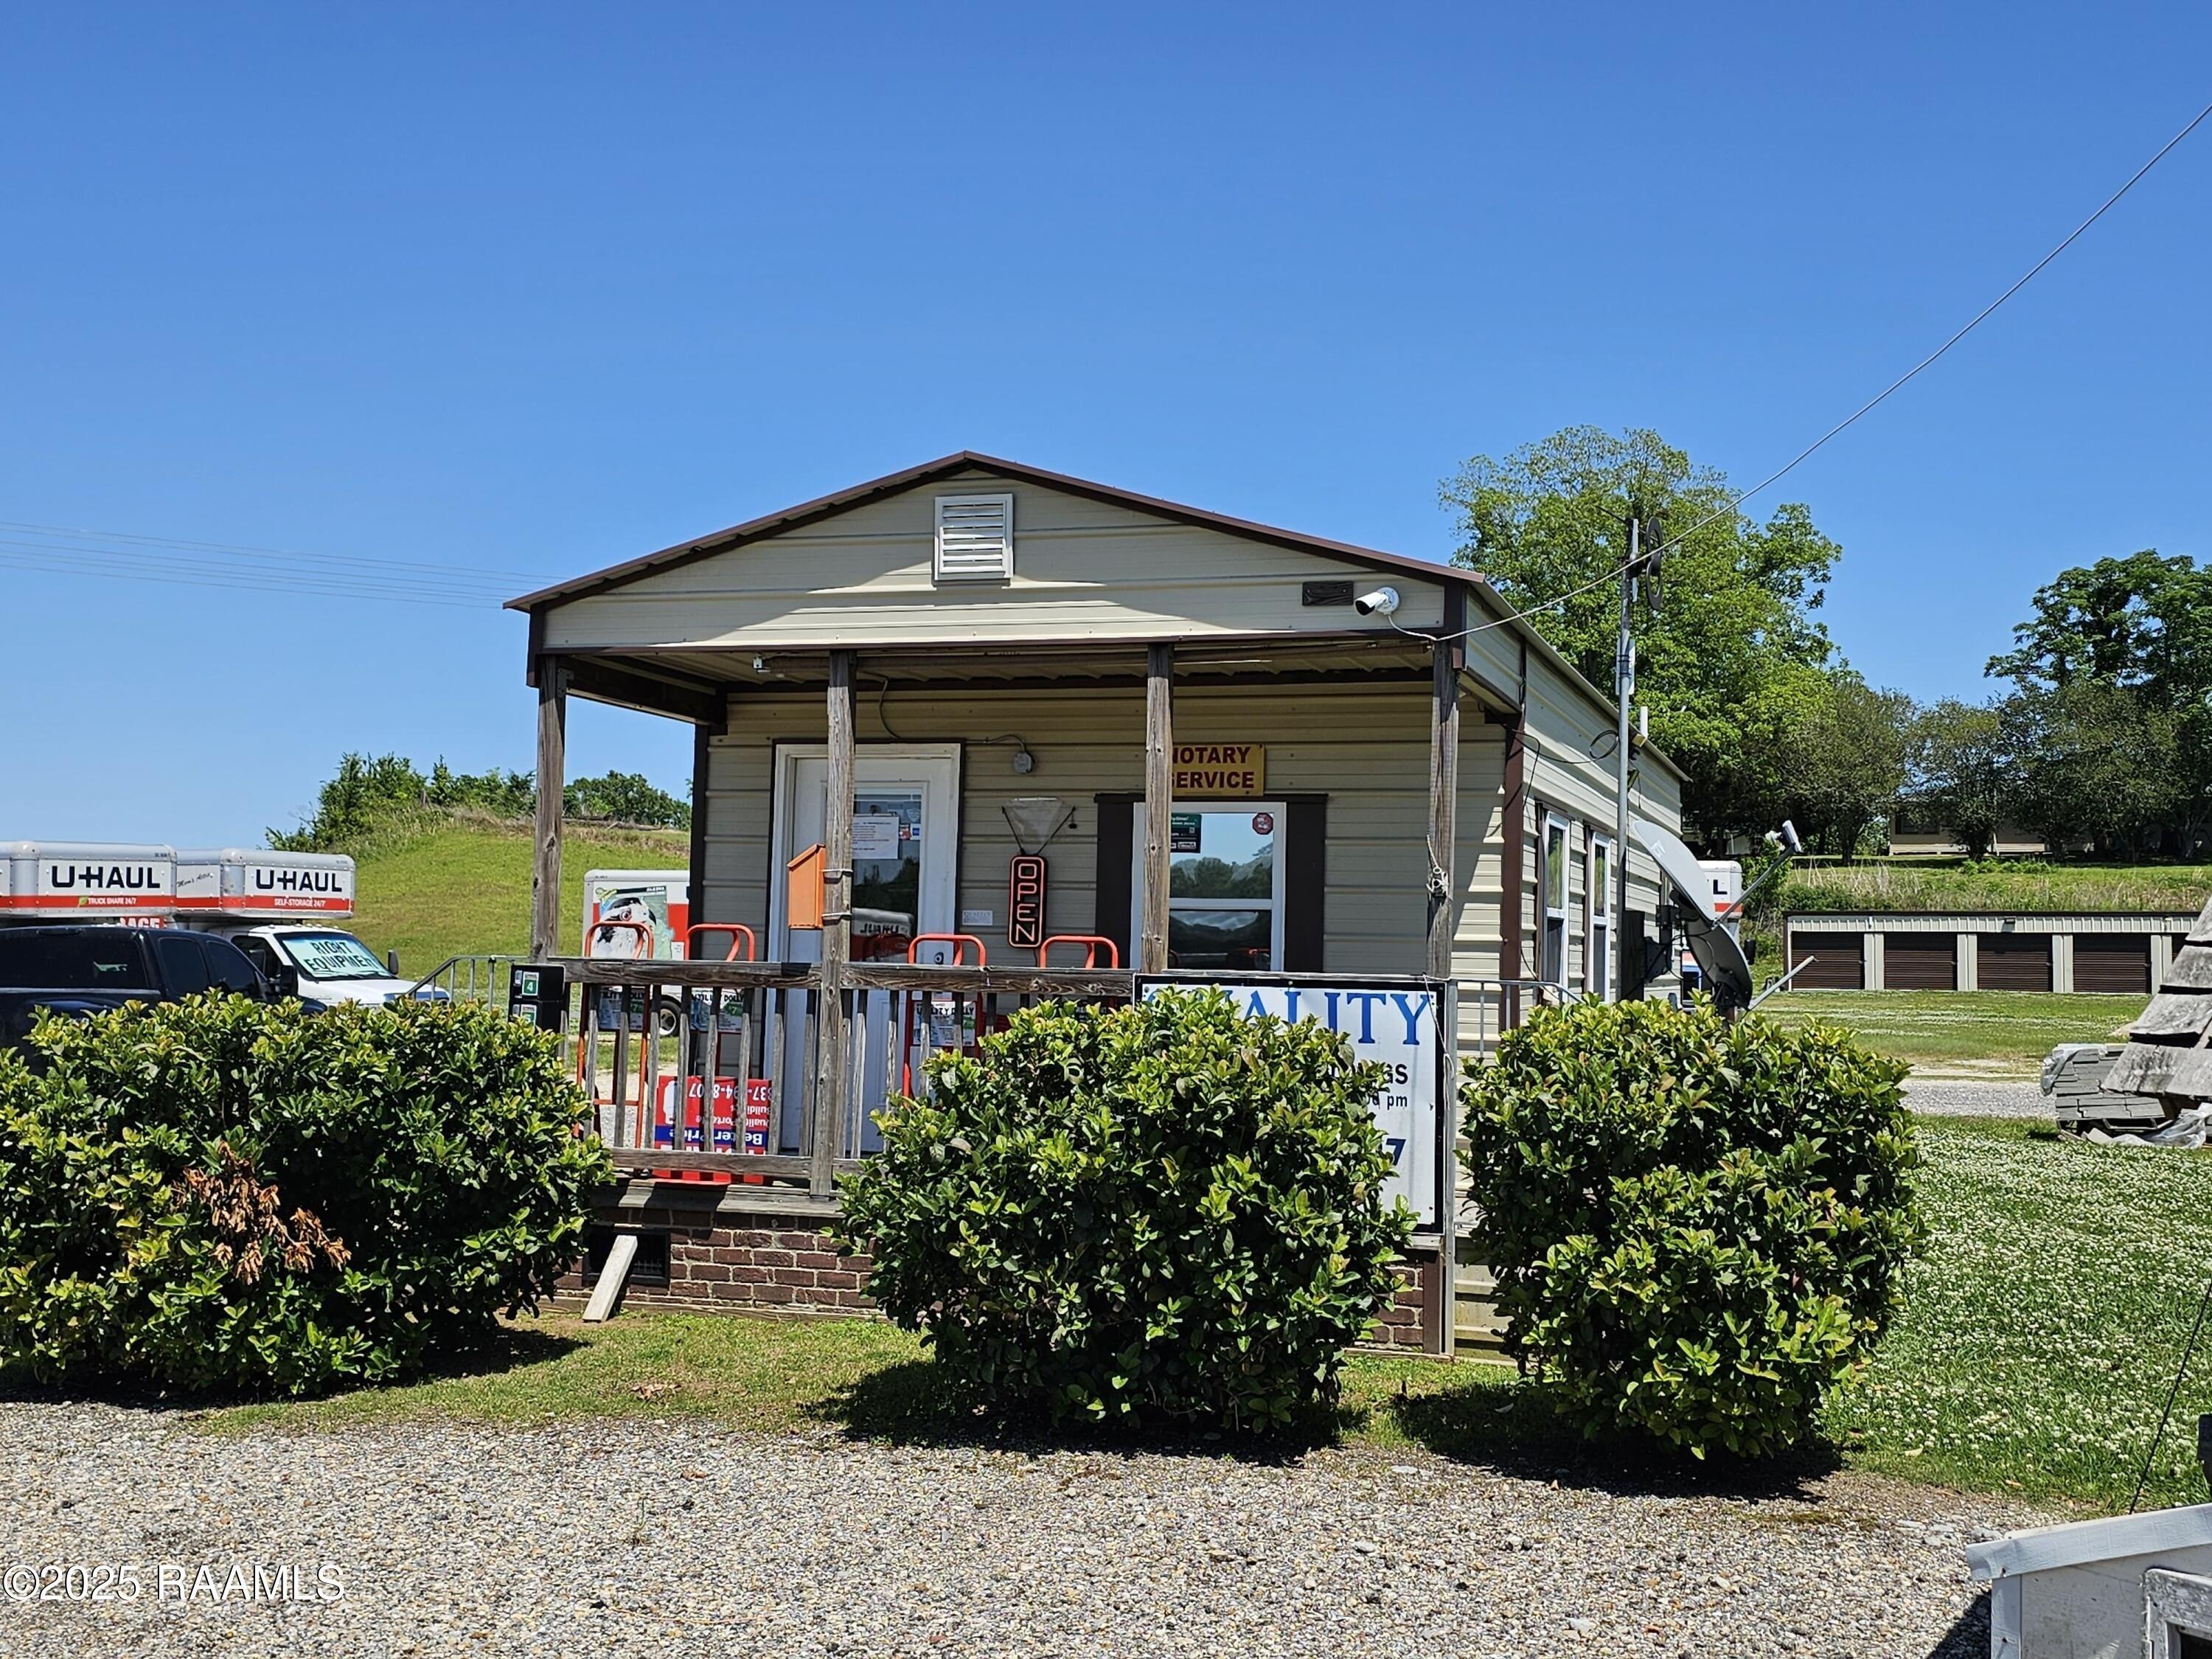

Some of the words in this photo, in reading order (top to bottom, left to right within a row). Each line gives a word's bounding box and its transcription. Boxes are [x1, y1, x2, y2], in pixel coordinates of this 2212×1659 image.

[1172, 771, 1255, 788] ERVICE
[52, 866, 161, 888] U-HAUL
[256, 869, 342, 892] U-HAUL
[88, 897, 106, 905] TRUCK
[274, 898, 313, 907] SELF-STORAGE
[1015, 863, 1037, 942] OPEN
[120, 917, 160, 928] AGE
[310, 941, 353, 954] RIGHT
[526, 981, 534, 992] 4
[1147, 989, 1433, 1046] ALITY
[1387, 1095, 1408, 1110] pm
[714, 1130, 763, 1145] Beter
